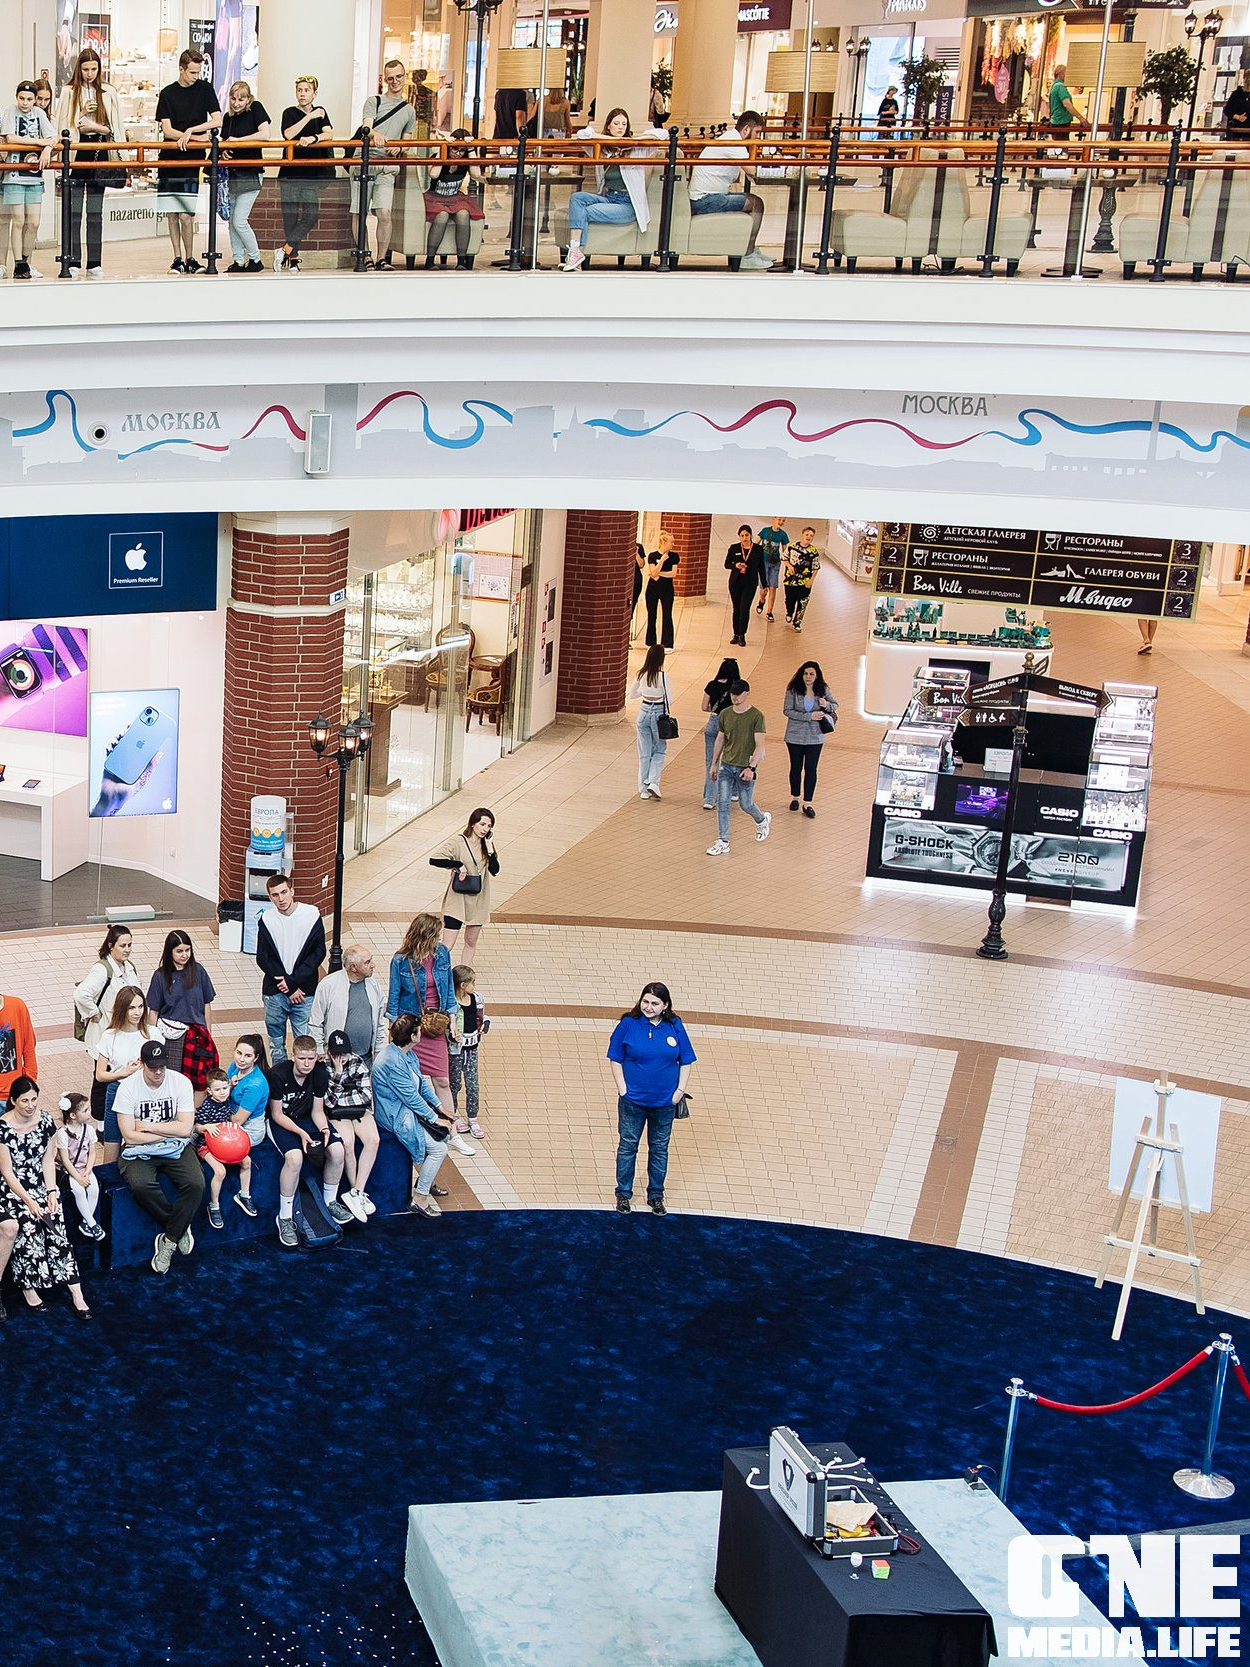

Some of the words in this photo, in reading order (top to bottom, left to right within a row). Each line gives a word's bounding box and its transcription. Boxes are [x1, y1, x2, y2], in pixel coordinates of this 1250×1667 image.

[110, 208, 154, 221] nazareno
[902, 393, 988, 417] МОСКВА
[121, 411, 221, 433] МОСКВА
[944, 527, 986, 537] ДЕТСКАЯ
[988, 530, 1027, 540] ГАЛЕРЕЯ
[1065, 536, 1124, 548] РЕСТОРАНЫ
[888, 547, 898, 559] 2
[1182, 543, 1192, 556] 3
[931, 551, 989, 564] РЕСТОРАНЫ
[886, 572, 893, 585] 1
[1084, 567, 1124, 578] ГАЛЕРЕЯ
[1125, 570, 1161, 581] ОБУВИ
[1177, 569, 1188, 583] 2
[913, 575, 936, 592] Bon
[939, 577, 963, 595] Ville
[967, 588, 990, 596] СВЕЖИЕ
[990, 591, 1021, 599] ПРОДУКТЫ
[1173, 596, 1184, 609] 2
[933, 692, 950, 705] Bon
[883, 807, 921, 818] CASIO
[1040, 807, 1079, 818] CASIO
[1092, 829, 1133, 840] CASIO
[895, 834, 954, 850] G-SHOCK
[894, 846, 921, 856] ABSOLUTE
[922, 850, 954, 859] TOUGHNESS
[1058, 852, 1100, 866] 2100
